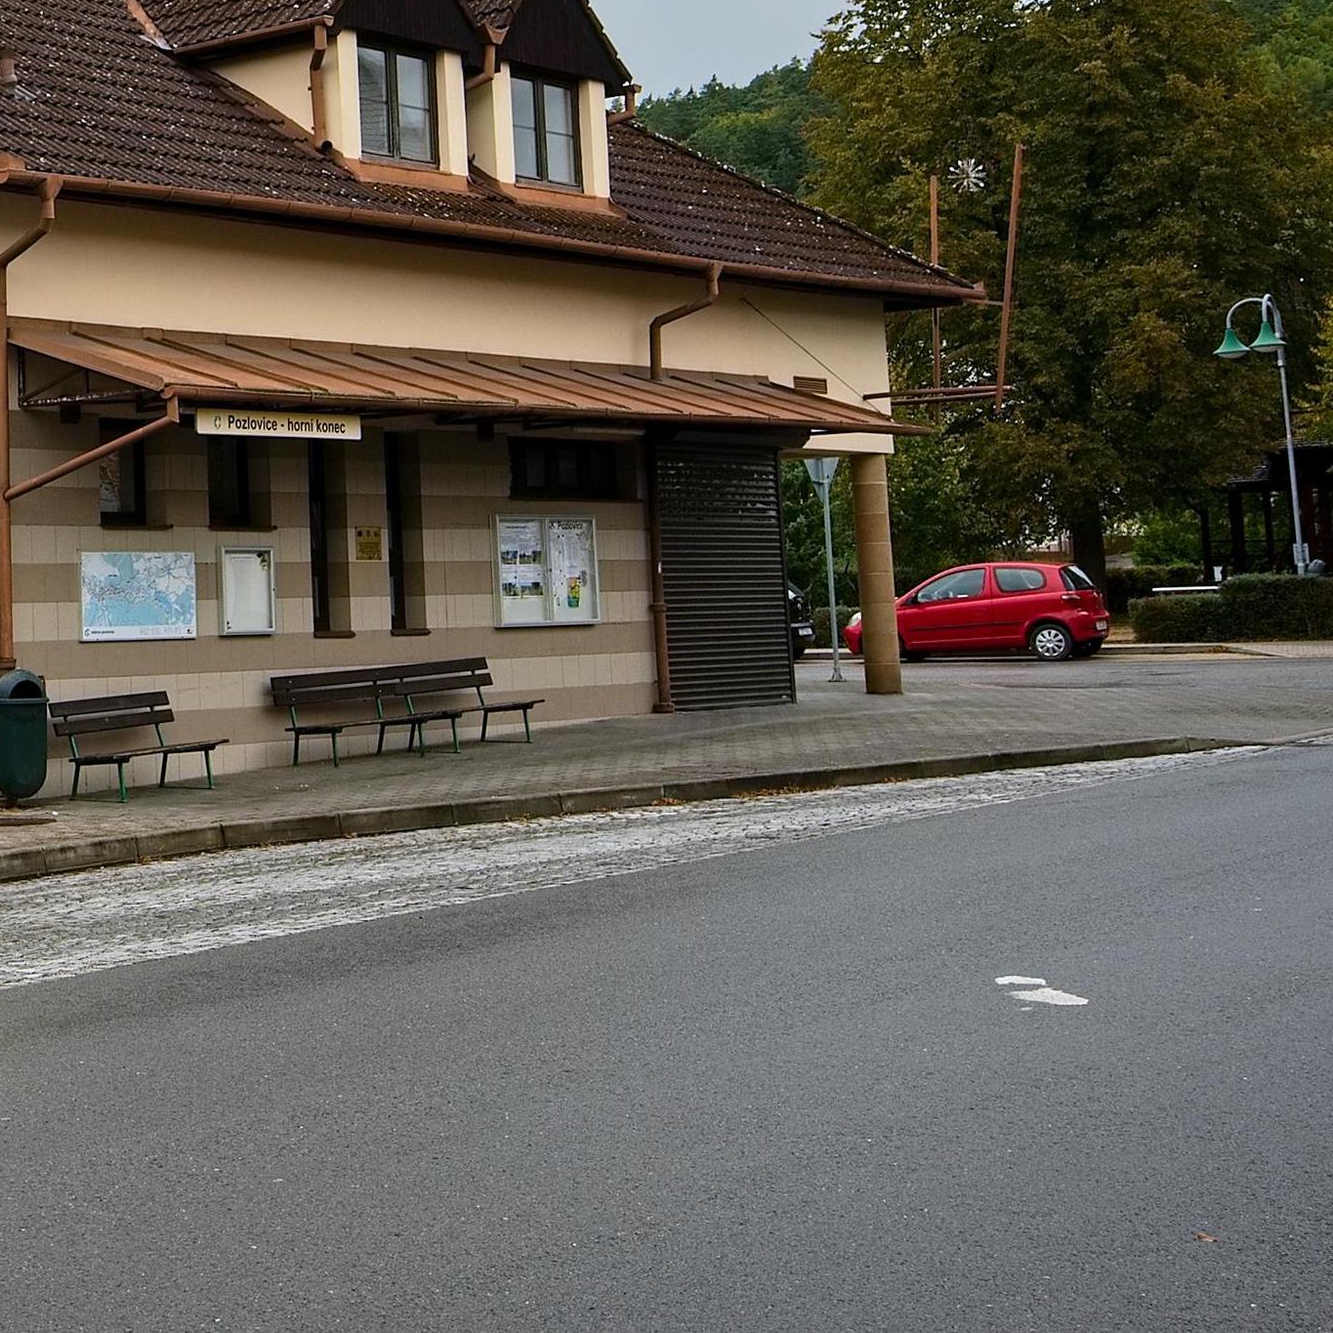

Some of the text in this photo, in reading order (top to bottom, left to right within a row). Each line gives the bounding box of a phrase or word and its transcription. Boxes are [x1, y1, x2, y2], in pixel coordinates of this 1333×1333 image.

[228, 415, 277, 431] Pozlovice
[287, 417, 314, 433] horní
[316, 419, 346, 434] konec
